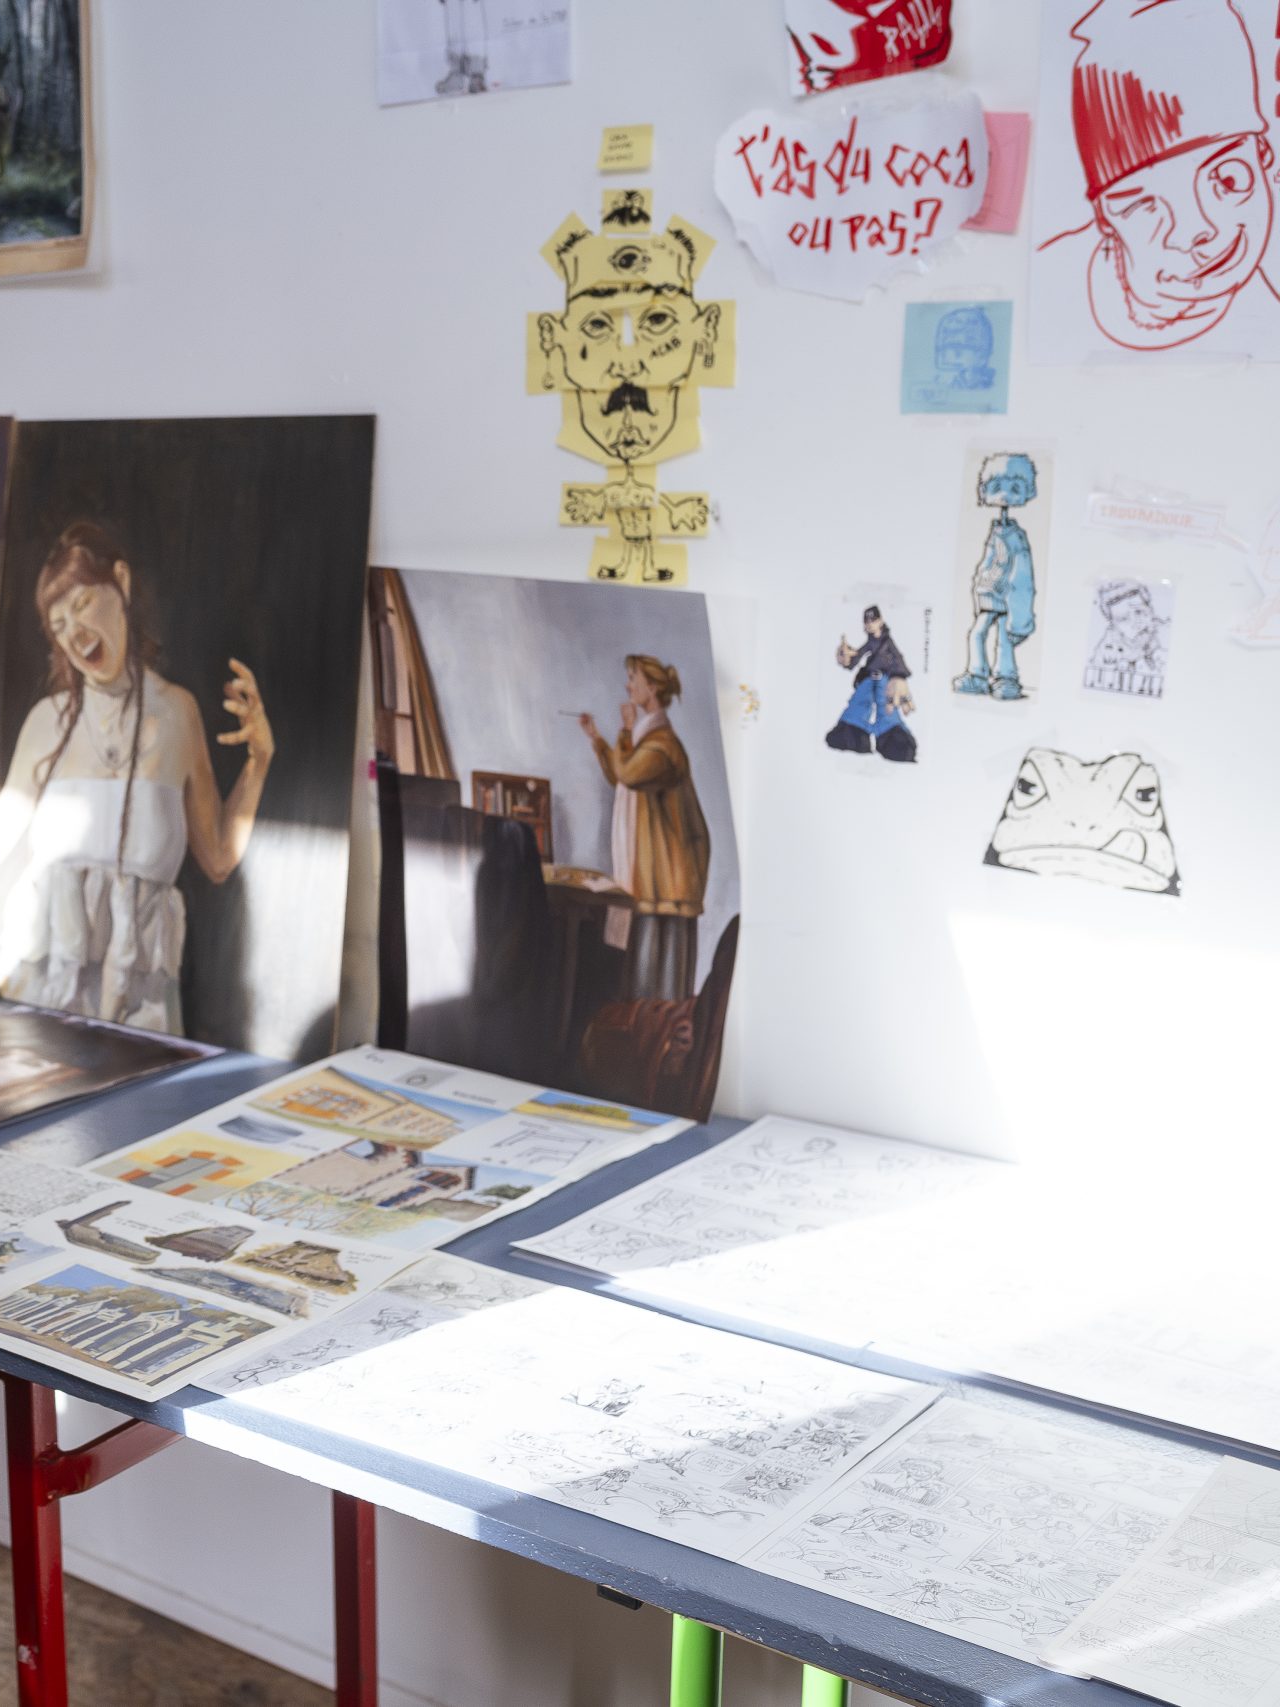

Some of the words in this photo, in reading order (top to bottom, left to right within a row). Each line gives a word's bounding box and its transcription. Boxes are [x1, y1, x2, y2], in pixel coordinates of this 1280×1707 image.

[734, 124, 817, 200] t'as
[823, 115, 871, 195] du
[884, 137, 975, 188] coca
[787, 216, 832, 254] ou
